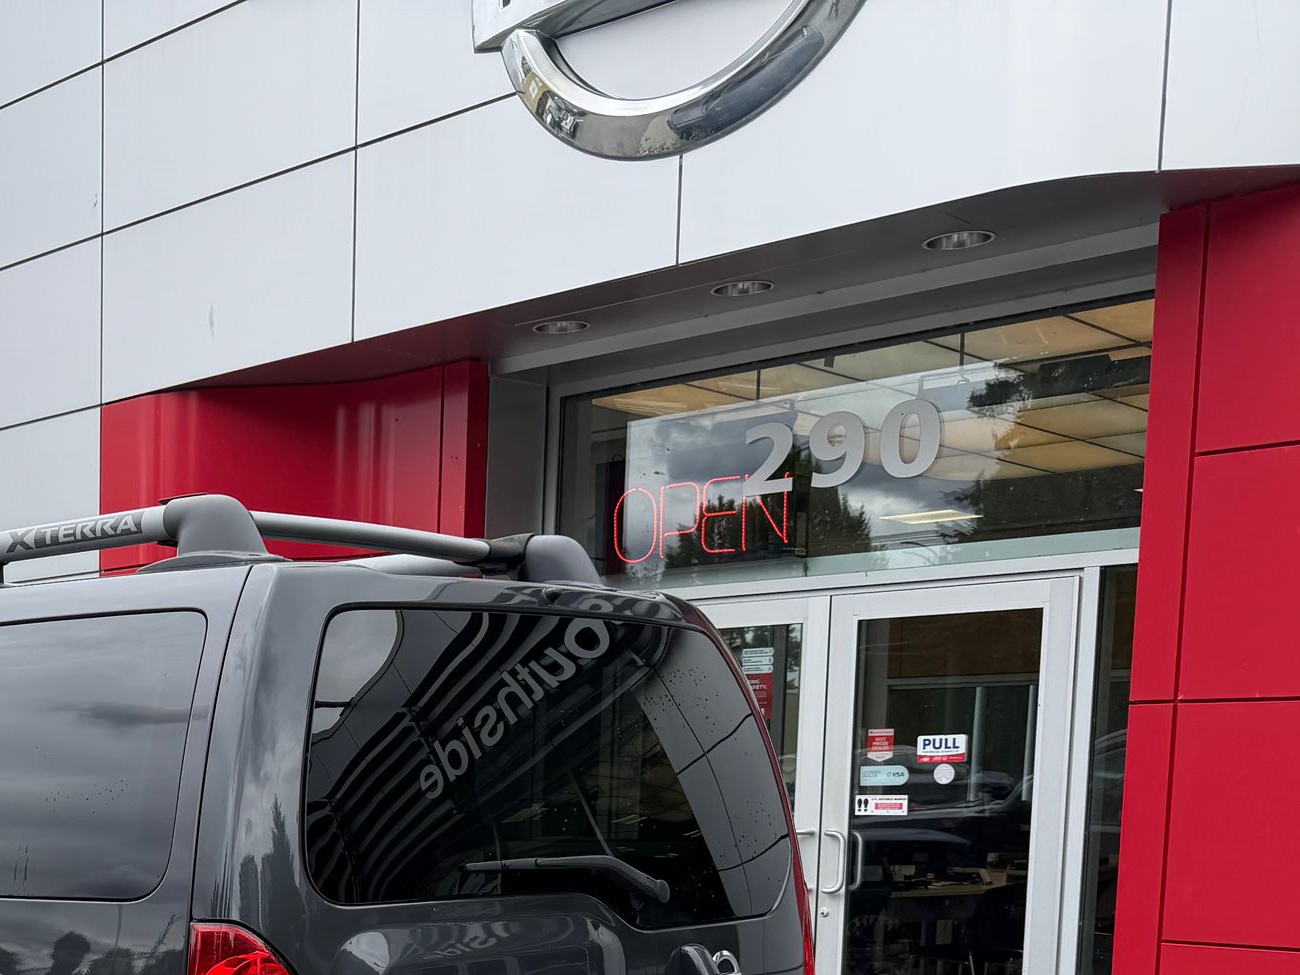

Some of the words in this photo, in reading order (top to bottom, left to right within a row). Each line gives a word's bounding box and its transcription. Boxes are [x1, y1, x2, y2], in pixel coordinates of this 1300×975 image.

[743, 399, 941, 497] 290
[7, 513, 141, 553] XTERRA
[614, 472, 789, 563] OPEN
[923, 737, 959, 750] PULL
